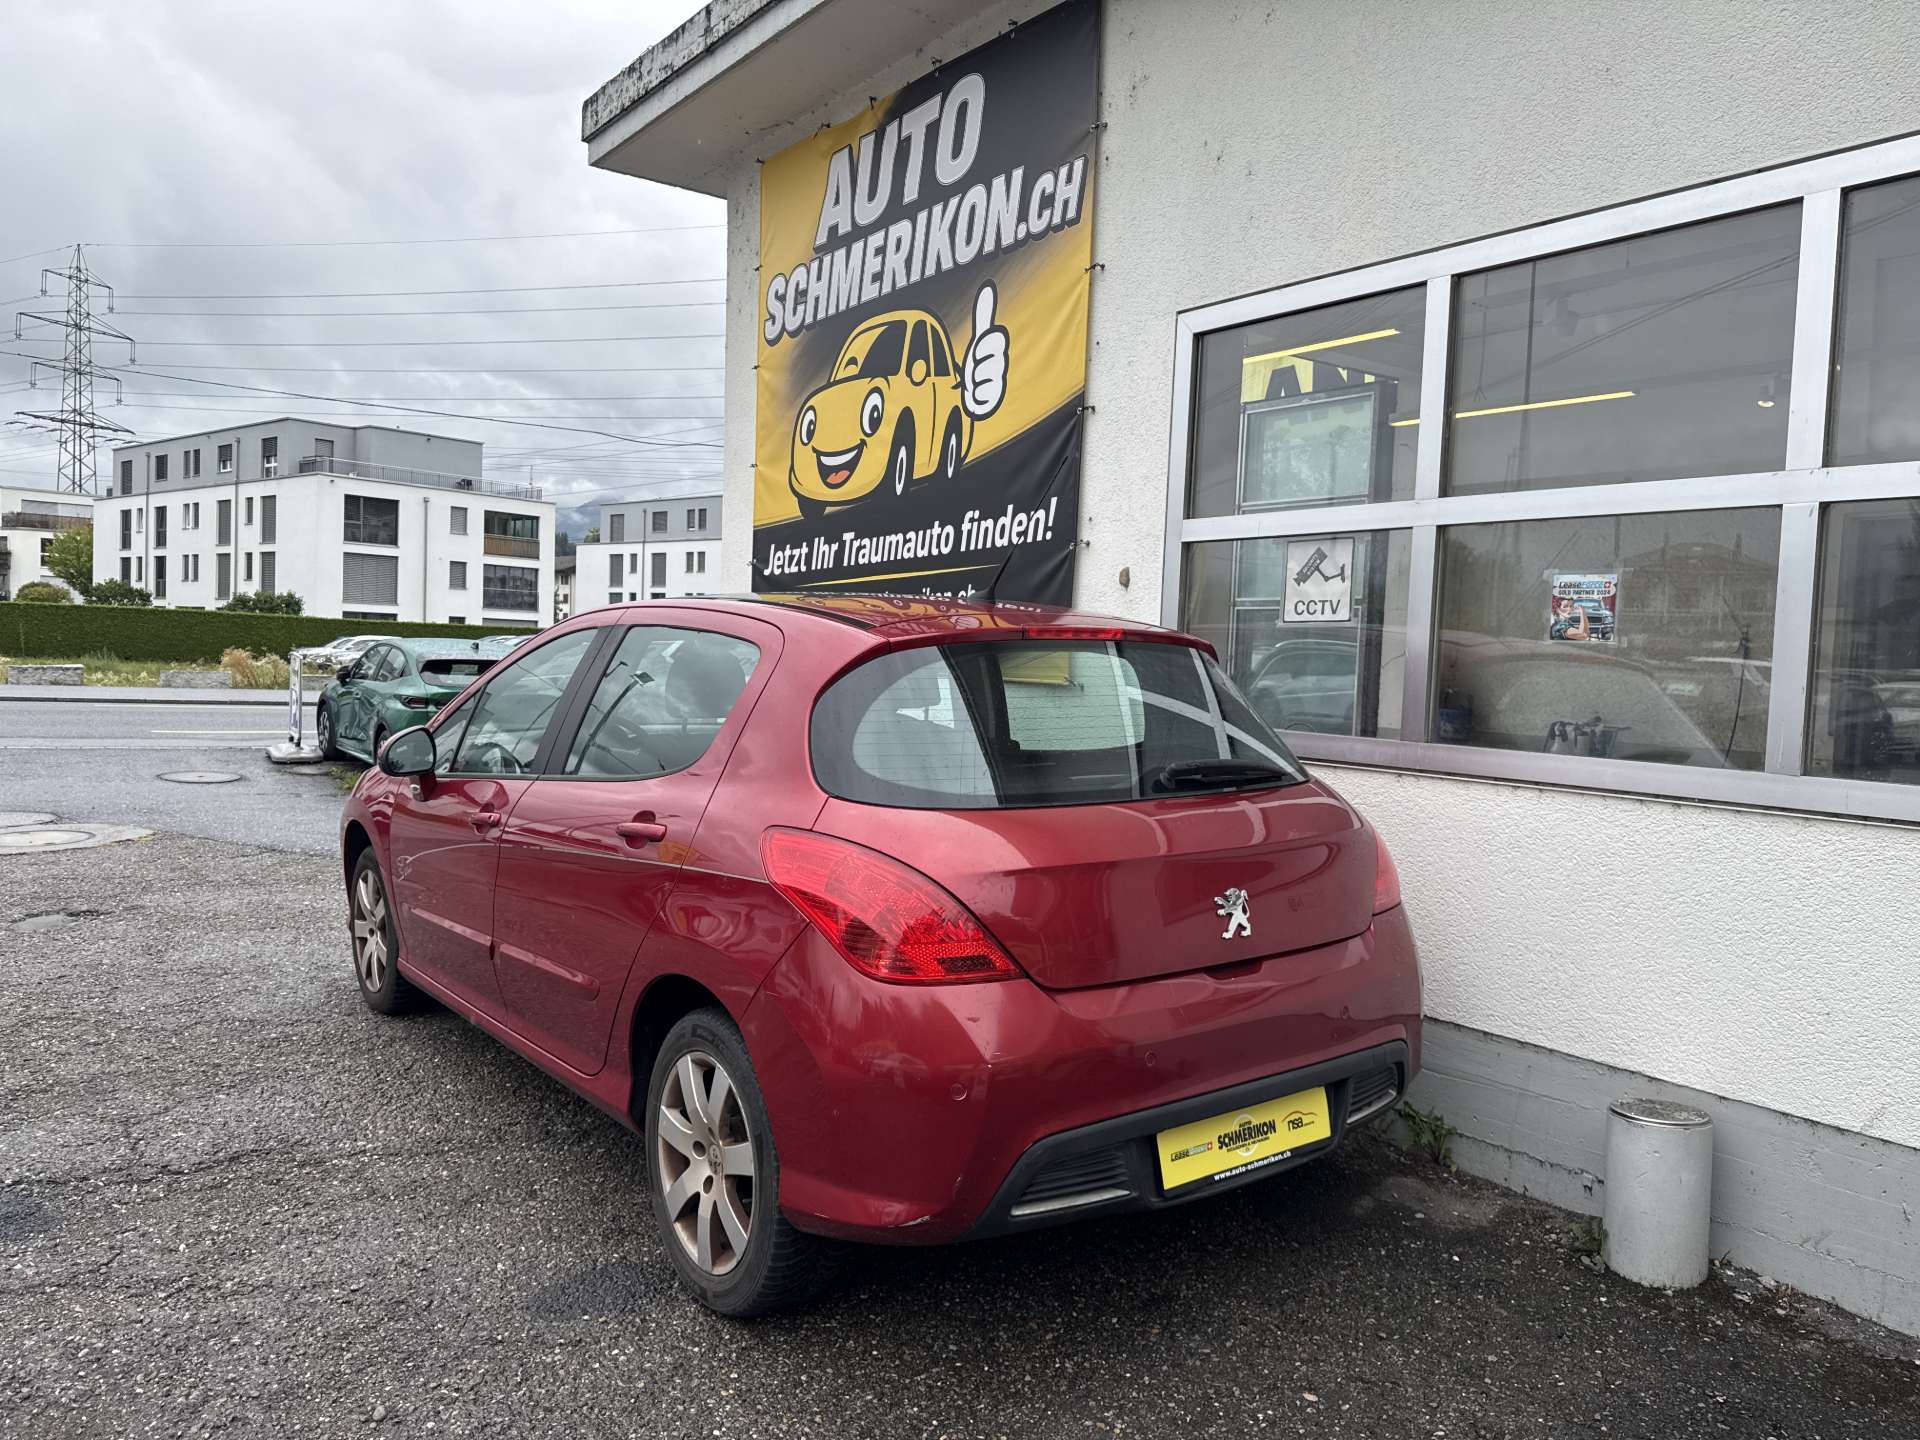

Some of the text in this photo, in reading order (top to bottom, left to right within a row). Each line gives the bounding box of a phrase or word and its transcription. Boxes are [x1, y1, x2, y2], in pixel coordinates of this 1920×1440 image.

[814, 73, 986, 249] AUTO
[763, 154, 1089, 342] SCHMERIKON.CH
[763, 496, 1058, 576] Jetzt Ihr Traumauto finden!
[1294, 599, 1341, 616] CCTV
[1217, 1119, 1277, 1150] SCHMERIKON
[1288, 1116, 1304, 1131] nsa
[1213, 1150, 1292, 1181] www.auto-schmerikon.ch
